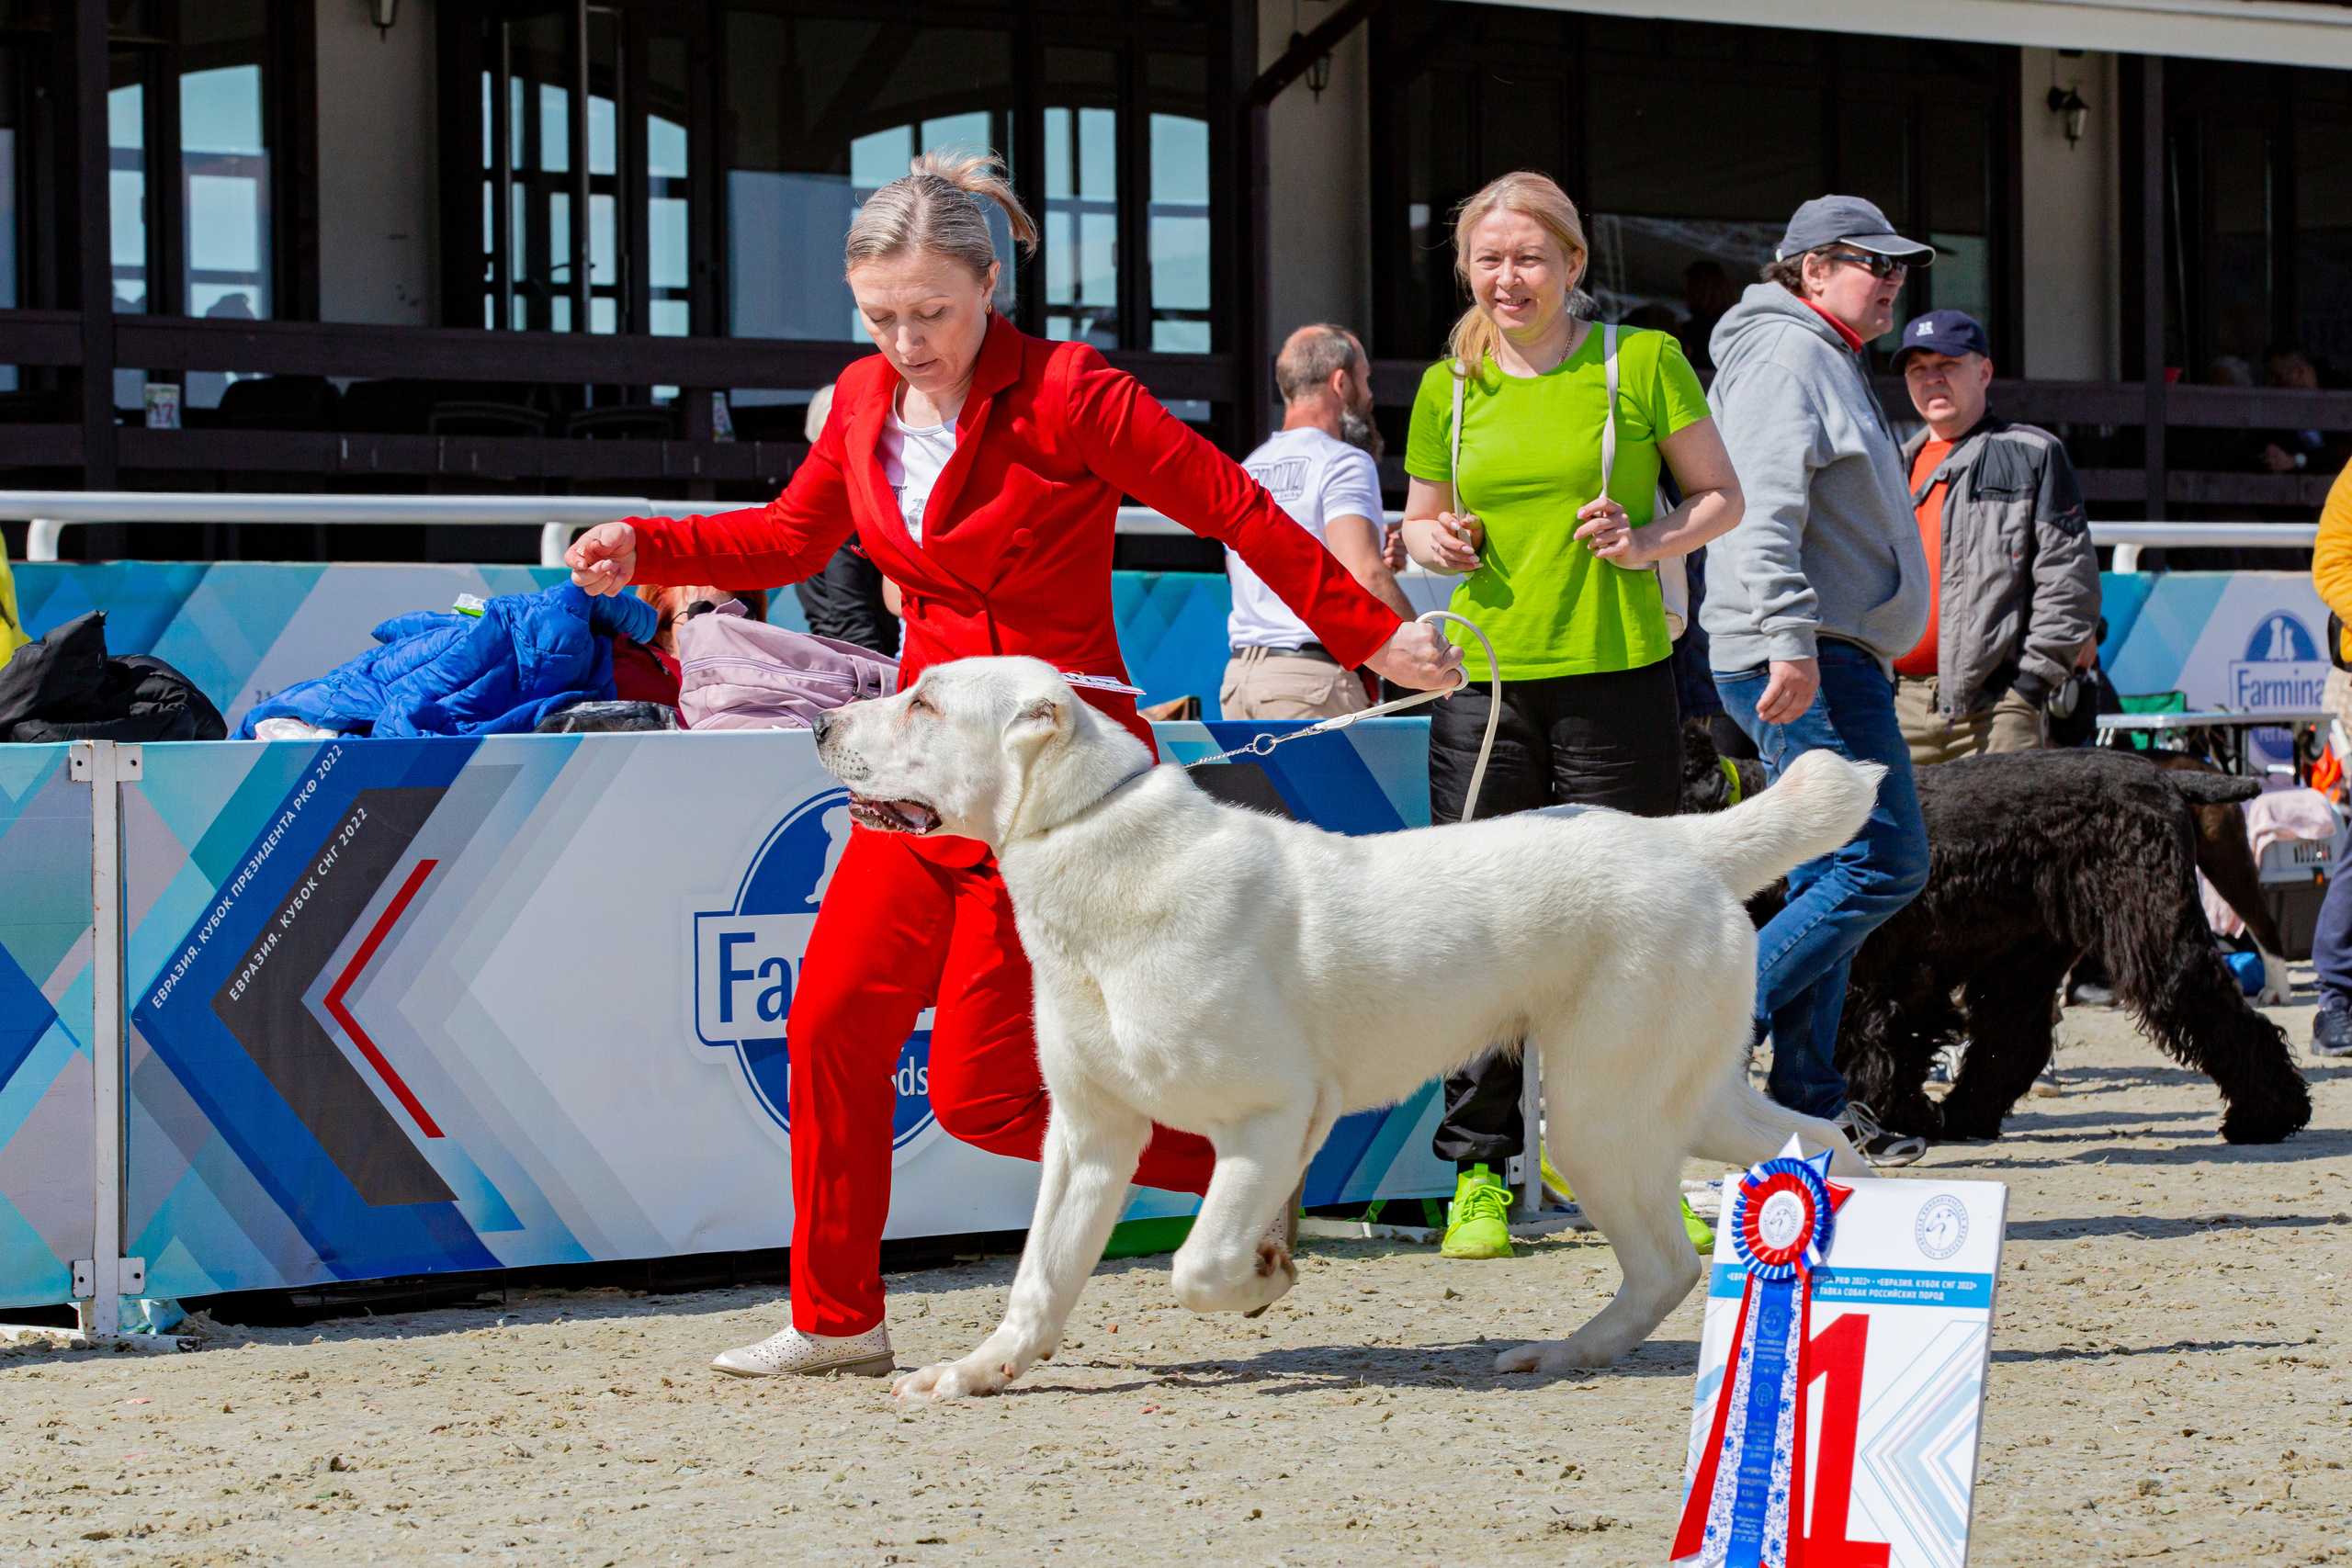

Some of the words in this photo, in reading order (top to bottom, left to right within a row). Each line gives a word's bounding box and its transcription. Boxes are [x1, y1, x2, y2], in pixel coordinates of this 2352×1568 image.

[2237, 669, 2324, 706] Farmina
[152, 945, 201, 1010] ЕВРАЗИЯ.
[198, 896, 233, 944] КУБОК
[231, 810, 296, 897] ПРЕЗИДЕНТА
[293, 779, 317, 811] РКФ
[315, 744, 343, 780] 2022
[229, 932, 282, 1001] ЕВРАЗИЯ.
[279, 876, 319, 929] КУБОК
[317, 845, 339, 876] СНГ
[339, 807, 368, 846] 2022
[1726, 1272, 1747, 1281] «ЕВРА
[1835, 1276, 1850, 1285] РКФ
[1916, 1280, 1940, 1289] КУБОК
[1941, 1280, 1956, 1289] СНГ
[1812, 1286, 1842, 1296] СТАВКА
[1843, 1287, 1867, 1297] СОБАК
[1869, 1288, 1917, 1299] РОССИЙСКИХ
[1918, 1291, 1945, 1301] ПОРОД
[1792, 1314, 1891, 1568] 1
